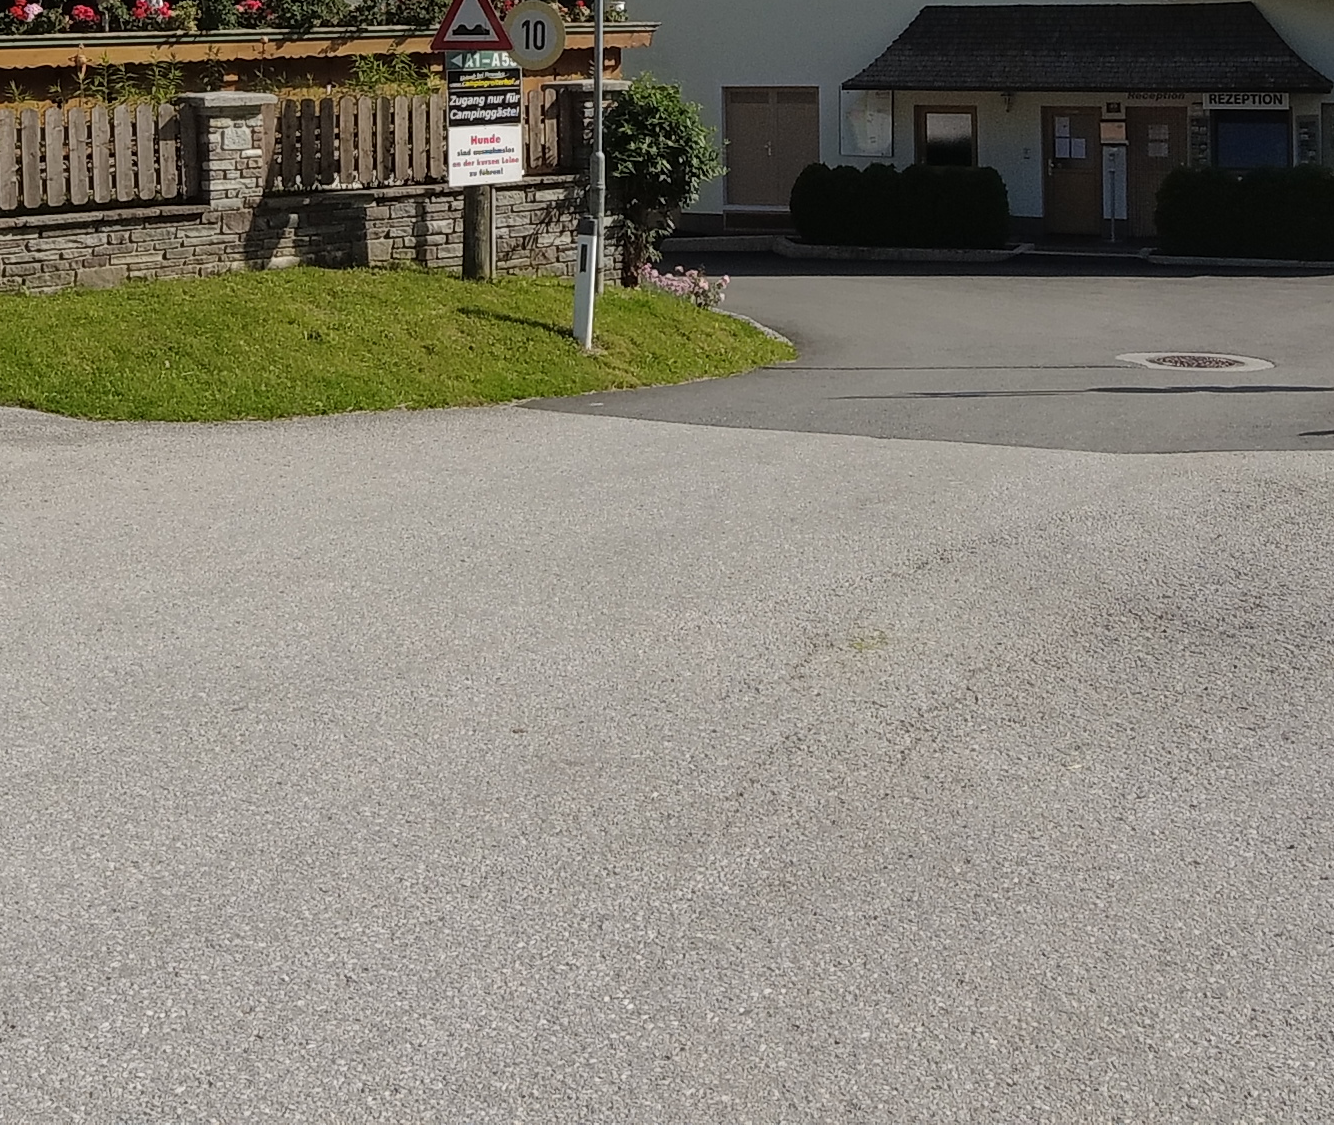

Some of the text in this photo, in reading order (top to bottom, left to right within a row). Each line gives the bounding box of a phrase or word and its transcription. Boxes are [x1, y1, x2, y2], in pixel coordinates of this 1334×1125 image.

[521, 19, 546, 51] 10
[449, 92, 521, 108] Zugang nur für
[1127, 91, 1186, 101] Reception
[1208, 93, 1284, 105] REZEPTION
[450, 106, 520, 121] Campinggäste!
[470, 133, 501, 145] Hunde
[457, 148, 471, 156] sind
[463, 159, 475, 167] der
